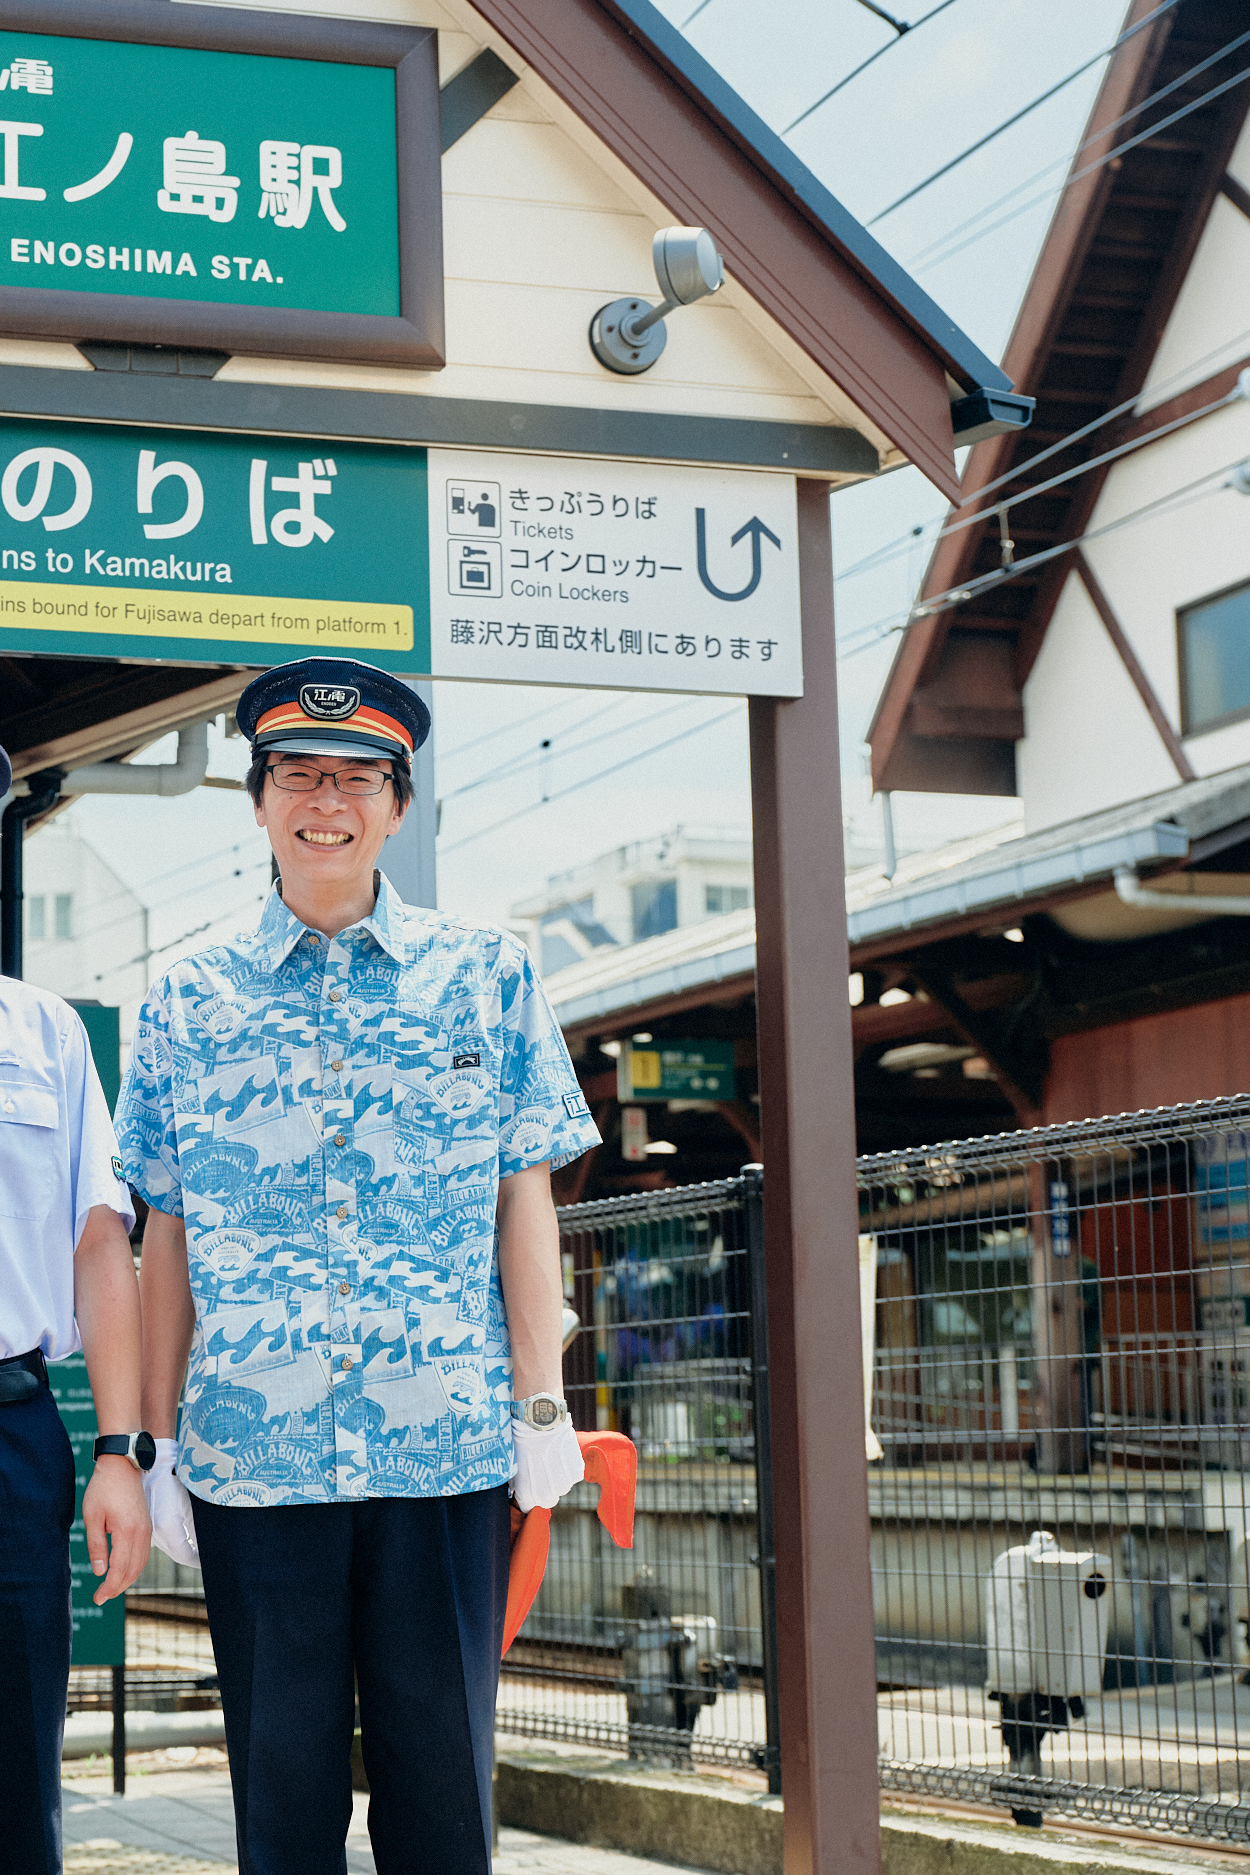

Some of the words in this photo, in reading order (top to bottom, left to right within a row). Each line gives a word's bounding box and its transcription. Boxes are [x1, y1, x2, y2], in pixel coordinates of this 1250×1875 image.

[11, 238, 197, 277] ENOSHIMA
[211, 255, 284, 284] STA.
[509, 488, 658, 520] きっぷうりば
[509, 520, 574, 541] Tickets
[46, 549, 74, 574] to
[84, 549, 233, 583] Kamakura
[509, 548, 683, 579] コインロッカー
[510, 579, 552, 598] Coin
[559, 582, 629, 603] Lockers
[32, 597, 88, 618] bound
[94, 600, 119, 619] for
[124, 602, 204, 626] Fujisawa
[208, 607, 266, 631] depart
[270, 609, 311, 631] from
[316, 611, 387, 637] platform
[393, 619, 409, 637] 1.
[450, 618, 779, 662] 藤沢方面改札側にあります
[436, 1071, 485, 1098] BILLABONG
[225, 1193, 306, 1225] BILLABONG
[203, 1233, 256, 1257] BILLABONG
[236, 1443, 314, 1479] BILLABONG
[376, 1481, 405, 1489] AUSTRALIA
